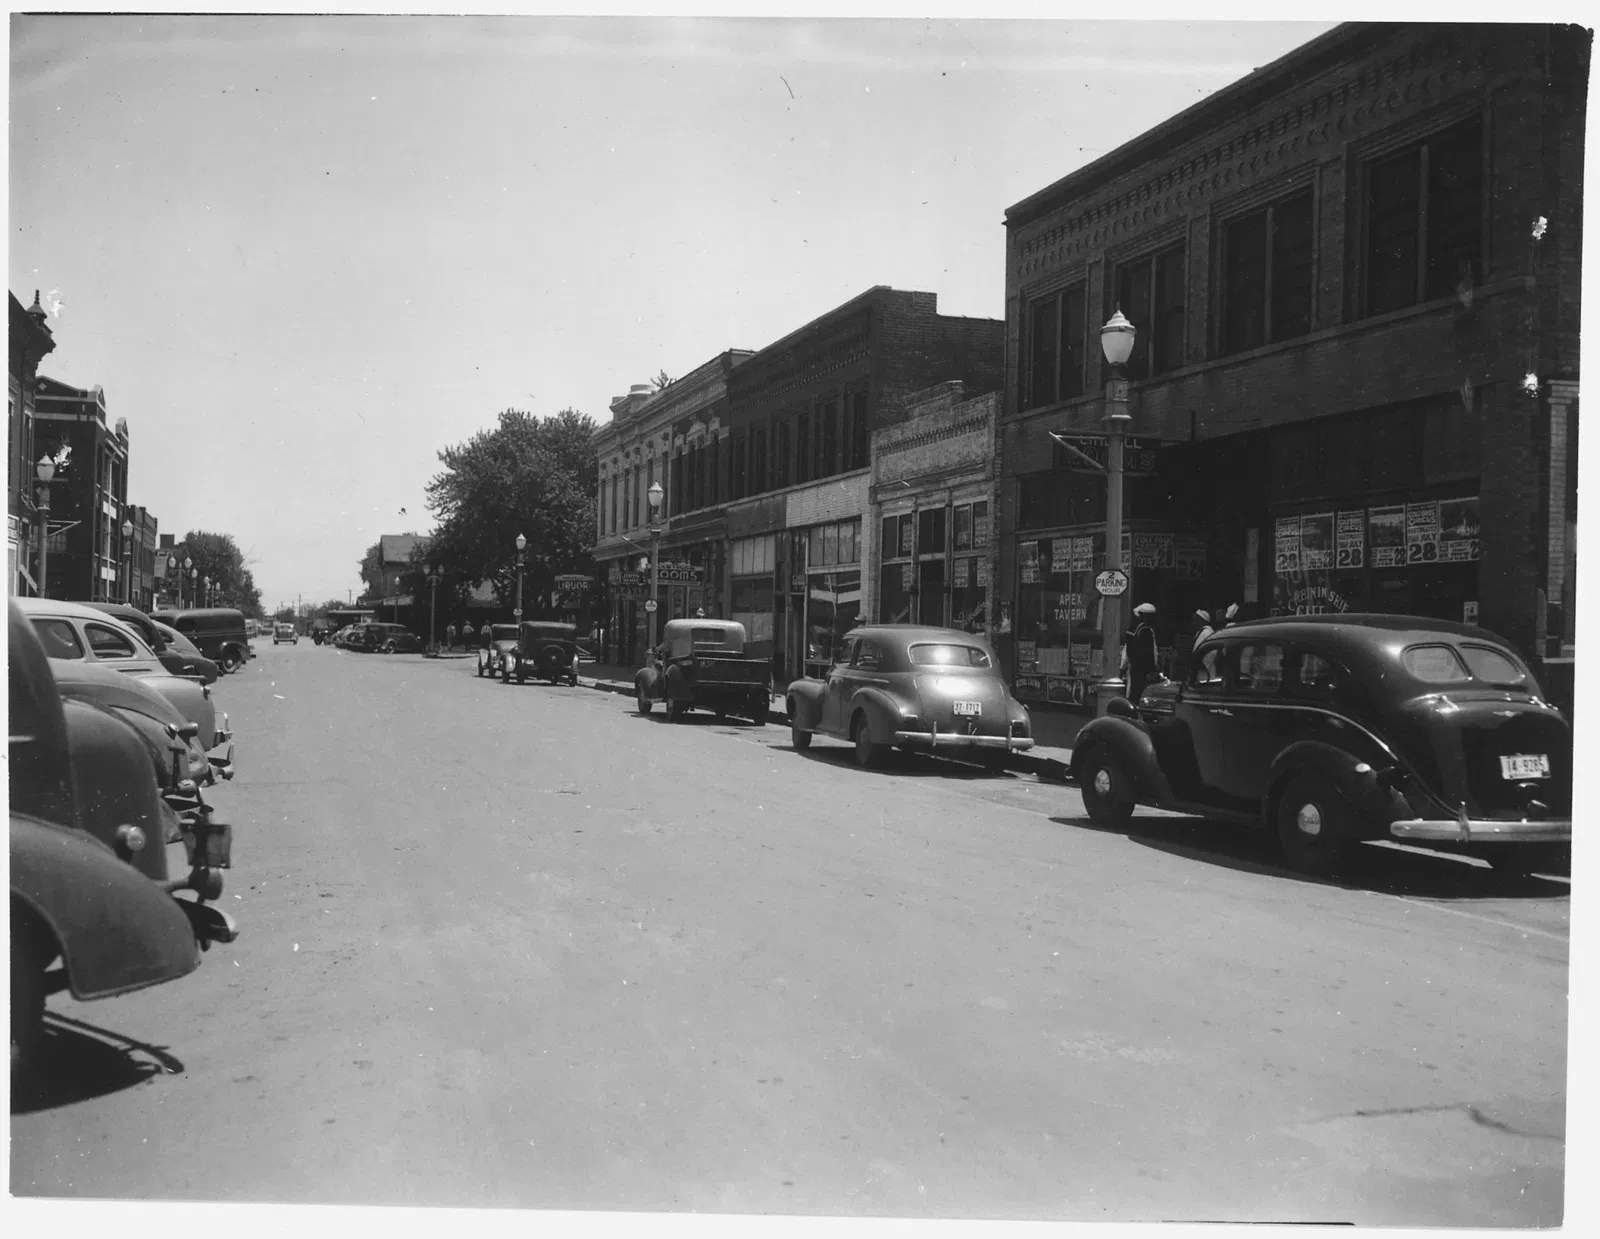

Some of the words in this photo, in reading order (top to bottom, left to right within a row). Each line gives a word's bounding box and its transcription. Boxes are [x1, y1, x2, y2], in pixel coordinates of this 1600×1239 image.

[1339, 549, 1362, 566] 28
[1409, 542, 1437, 561] 28
[1277, 553, 1298, 570] 28
[656, 570, 697, 582] OOMS
[1108, 571, 1115, 579] 2
[1096, 578, 1127, 588] PARKING
[1059, 593, 1083, 605] APEX
[1054, 608, 1087, 620] TAVERN
